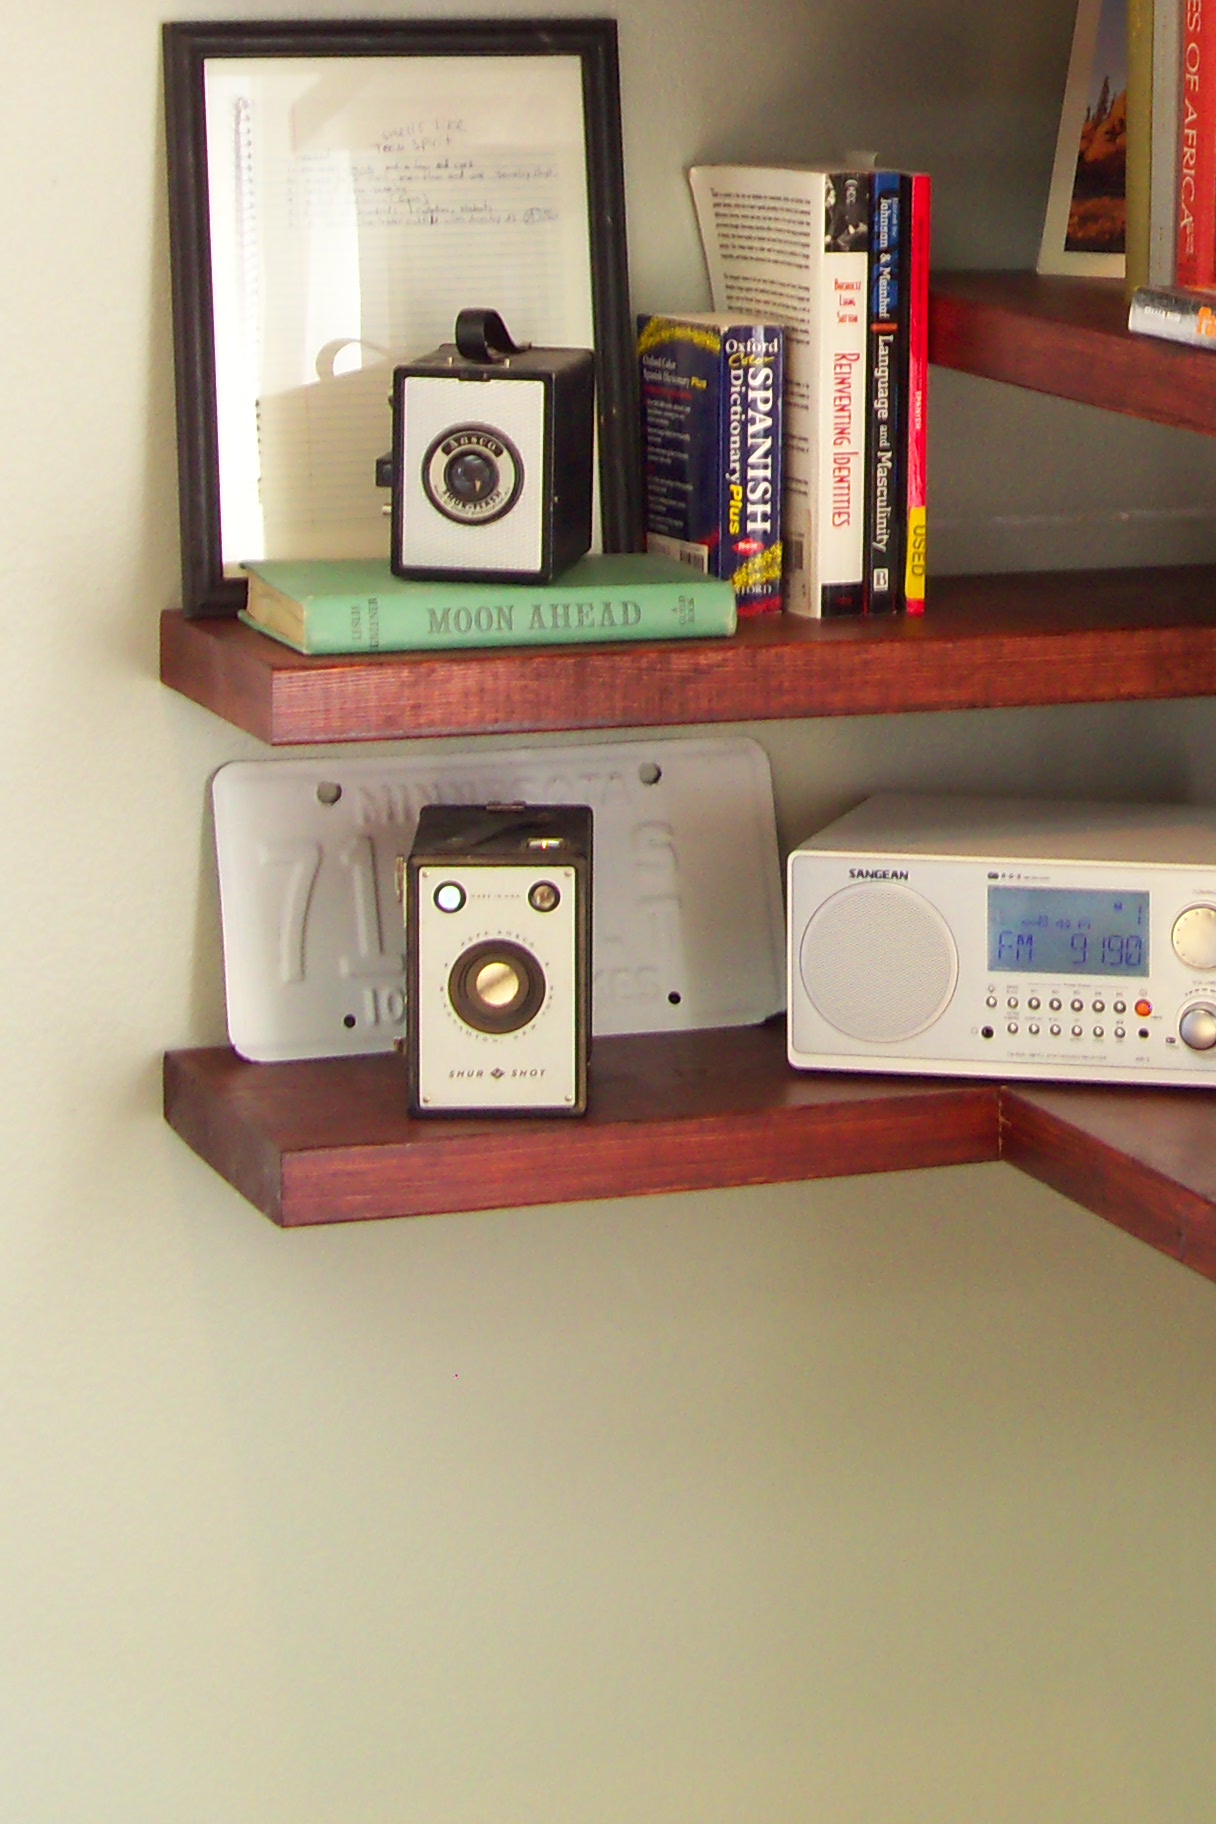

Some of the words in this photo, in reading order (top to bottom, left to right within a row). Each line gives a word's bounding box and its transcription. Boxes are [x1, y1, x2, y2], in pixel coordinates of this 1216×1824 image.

[1185, 41, 1200, 93] OF
[1180, 99, 1198, 229] AFRICA
[879, 197, 892, 248] Johnson
[879, 251, 891, 263] &
[725, 337, 780, 354] Oxford
[728, 351, 775, 369] Color
[833, 352, 861, 447] REINVENTING
[872, 334, 894, 420] Language
[725, 368, 746, 484] Dictionary
[746, 366, 774, 535] SPANISH
[880, 423, 891, 447] and
[729, 484, 743, 536] Plus
[832, 451, 859, 528] IDENTITIES
[872, 450, 893, 553] Masculinity
[911, 524, 926, 577] USED
[426, 604, 514, 635] MOON
[528, 599, 642, 631] AHEAD
[848, 868, 910, 882] SANGEAN
[998, 930, 1034, 963] FM
[448, 1068, 484, 1079] SHUR
[511, 1068, 546, 1078] SHOT
